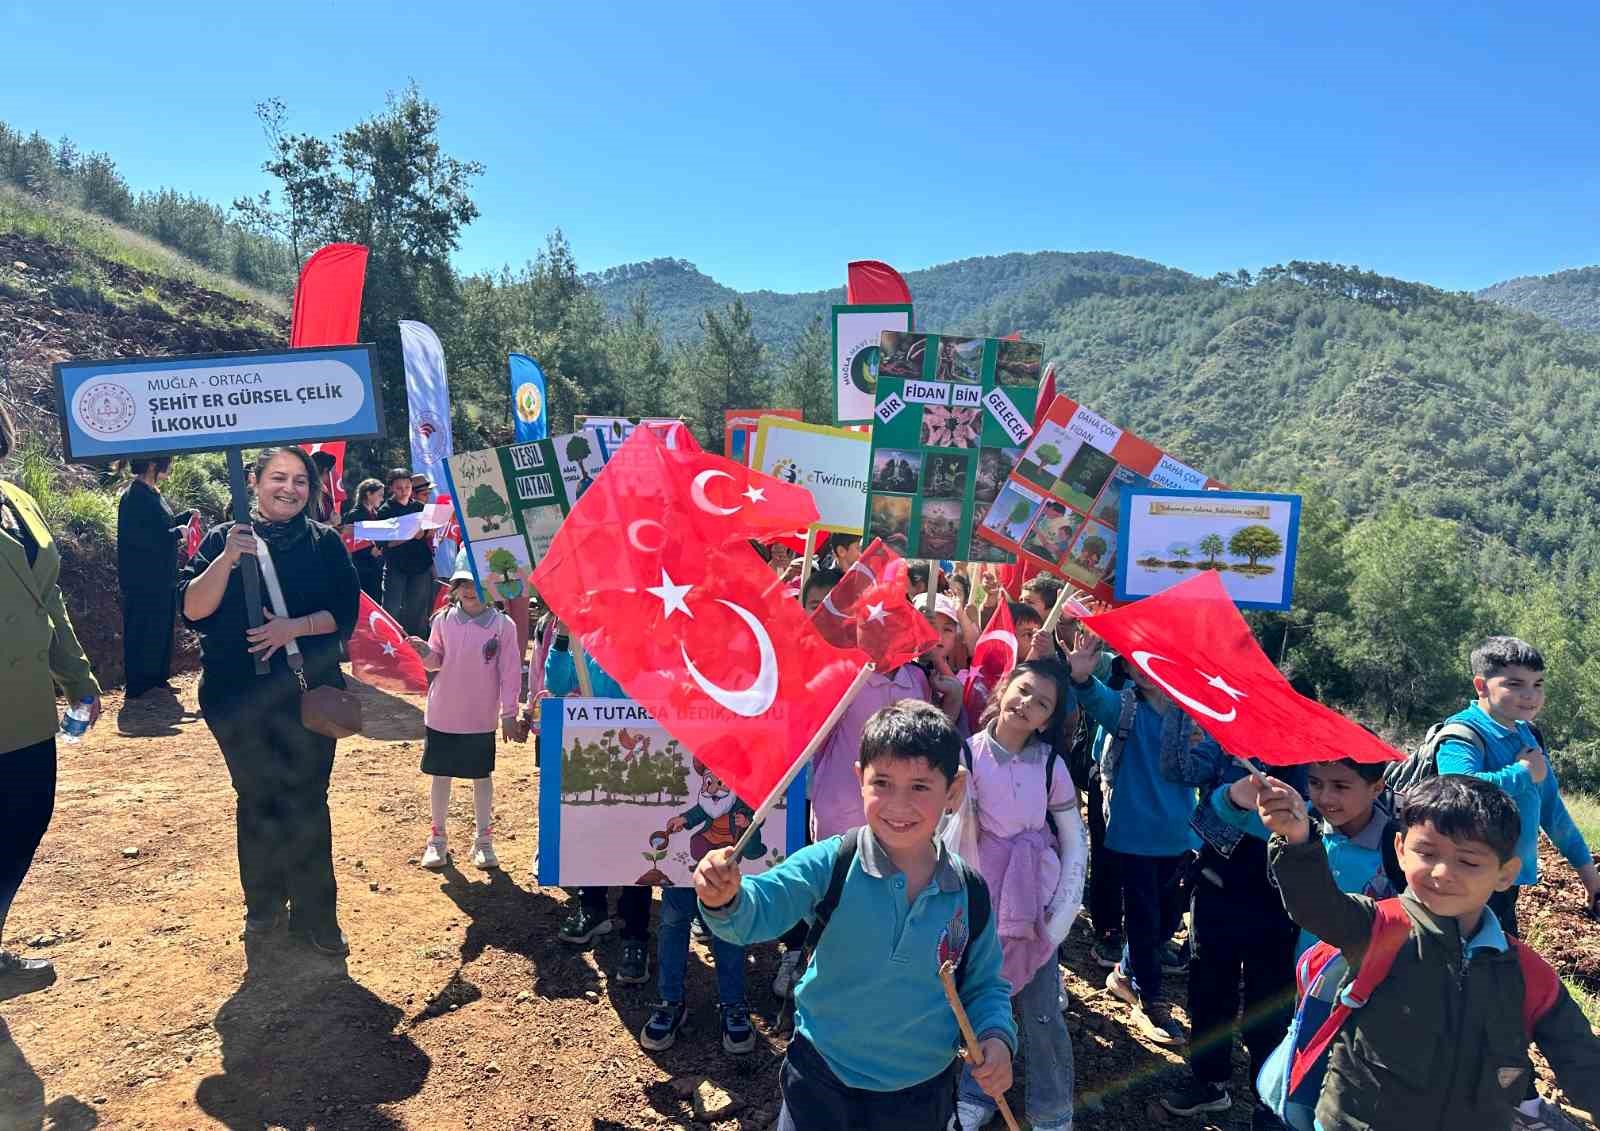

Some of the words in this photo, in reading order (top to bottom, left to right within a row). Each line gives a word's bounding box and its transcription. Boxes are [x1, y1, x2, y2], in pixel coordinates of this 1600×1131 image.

[147, 376, 198, 391] MUĞLA
[208, 373, 263, 387] ORTACA
[148, 394, 198, 414] ŞEHİT
[202, 392, 224, 407] ER
[228, 387, 293, 406] GÜRSEL
[296, 383, 343, 405] ÇELİK
[879, 398, 901, 419] BİR
[905, 383, 945, 400] FİDAN
[955, 387, 979, 402] BİN
[988, 393, 1028, 441] GELECEK
[1077, 410, 1100, 429] DAHA
[151, 413, 238, 433] İLKOKULU
[1160, 460, 1183, 478] DAHA
[516, 474, 552, 497] VATAN
[806, 470, 868, 493] eTwinning
[567, 707, 589, 720] YA
[593, 706, 669, 720] TUTARSA
